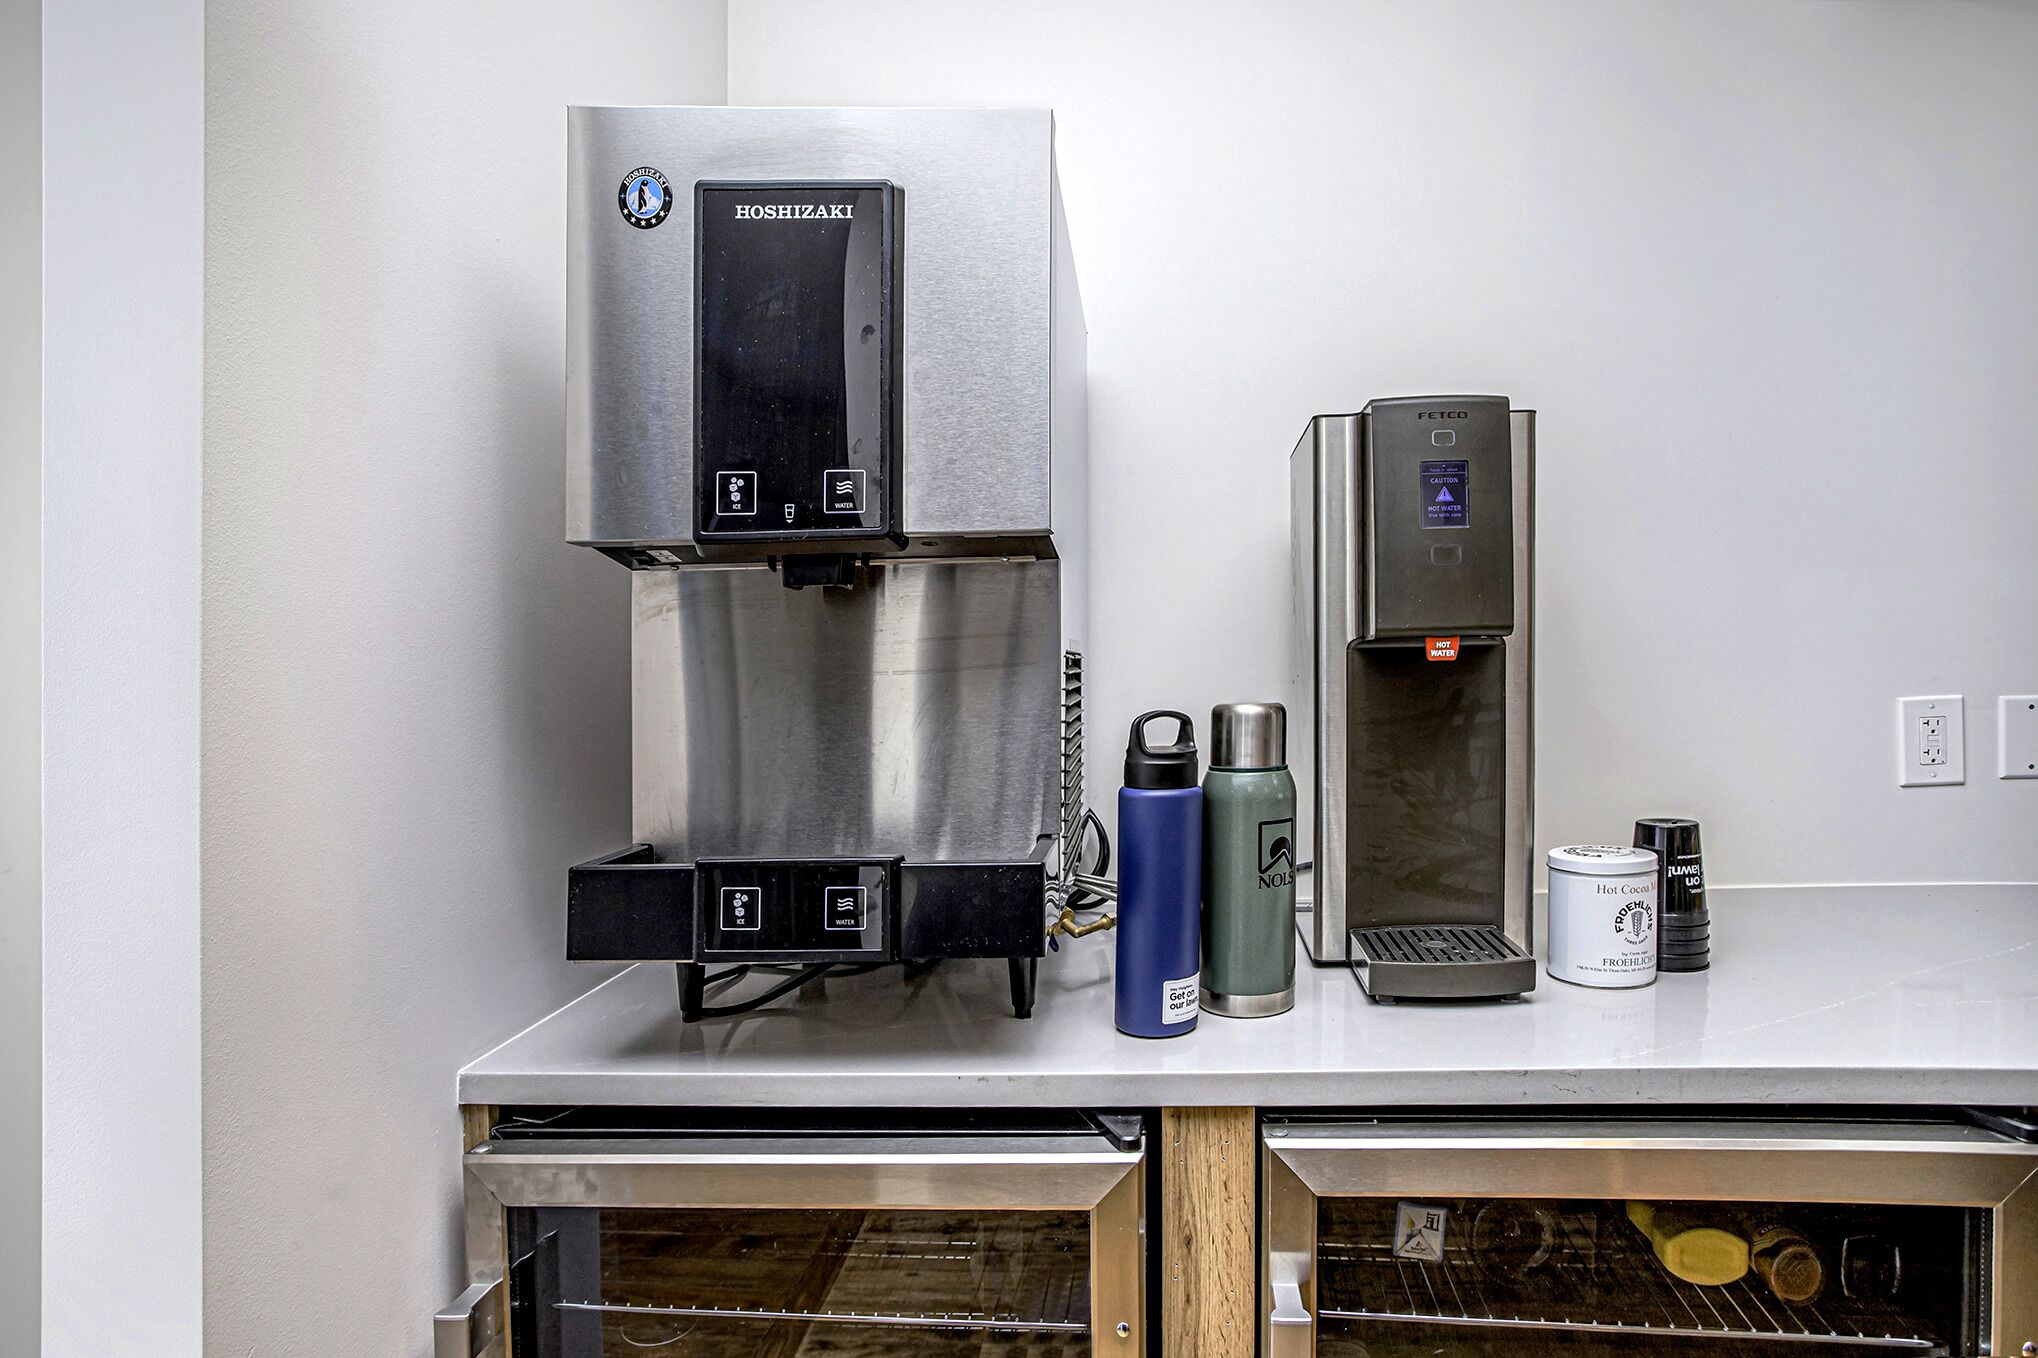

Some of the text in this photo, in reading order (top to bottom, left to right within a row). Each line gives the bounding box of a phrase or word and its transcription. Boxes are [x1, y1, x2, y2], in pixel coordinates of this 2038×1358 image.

[623, 168, 669, 188] HOSHIZAKI
[735, 204, 854, 219] HOSHIZAKI
[1418, 411, 1468, 420] FETCO
[1436, 641, 1451, 649] HOT
[1430, 649, 1455, 657] WATER
[1667, 864, 1700, 878] lawn!
[1258, 870, 1294, 889] NOLS
[1685, 876, 1700, 886] on
[1596, 884, 1618, 895] Hot
[1621, 884, 1650, 894] Cocoa
[1170, 991, 1186, 1001] Get
[1170, 1001, 1185, 1010] our
